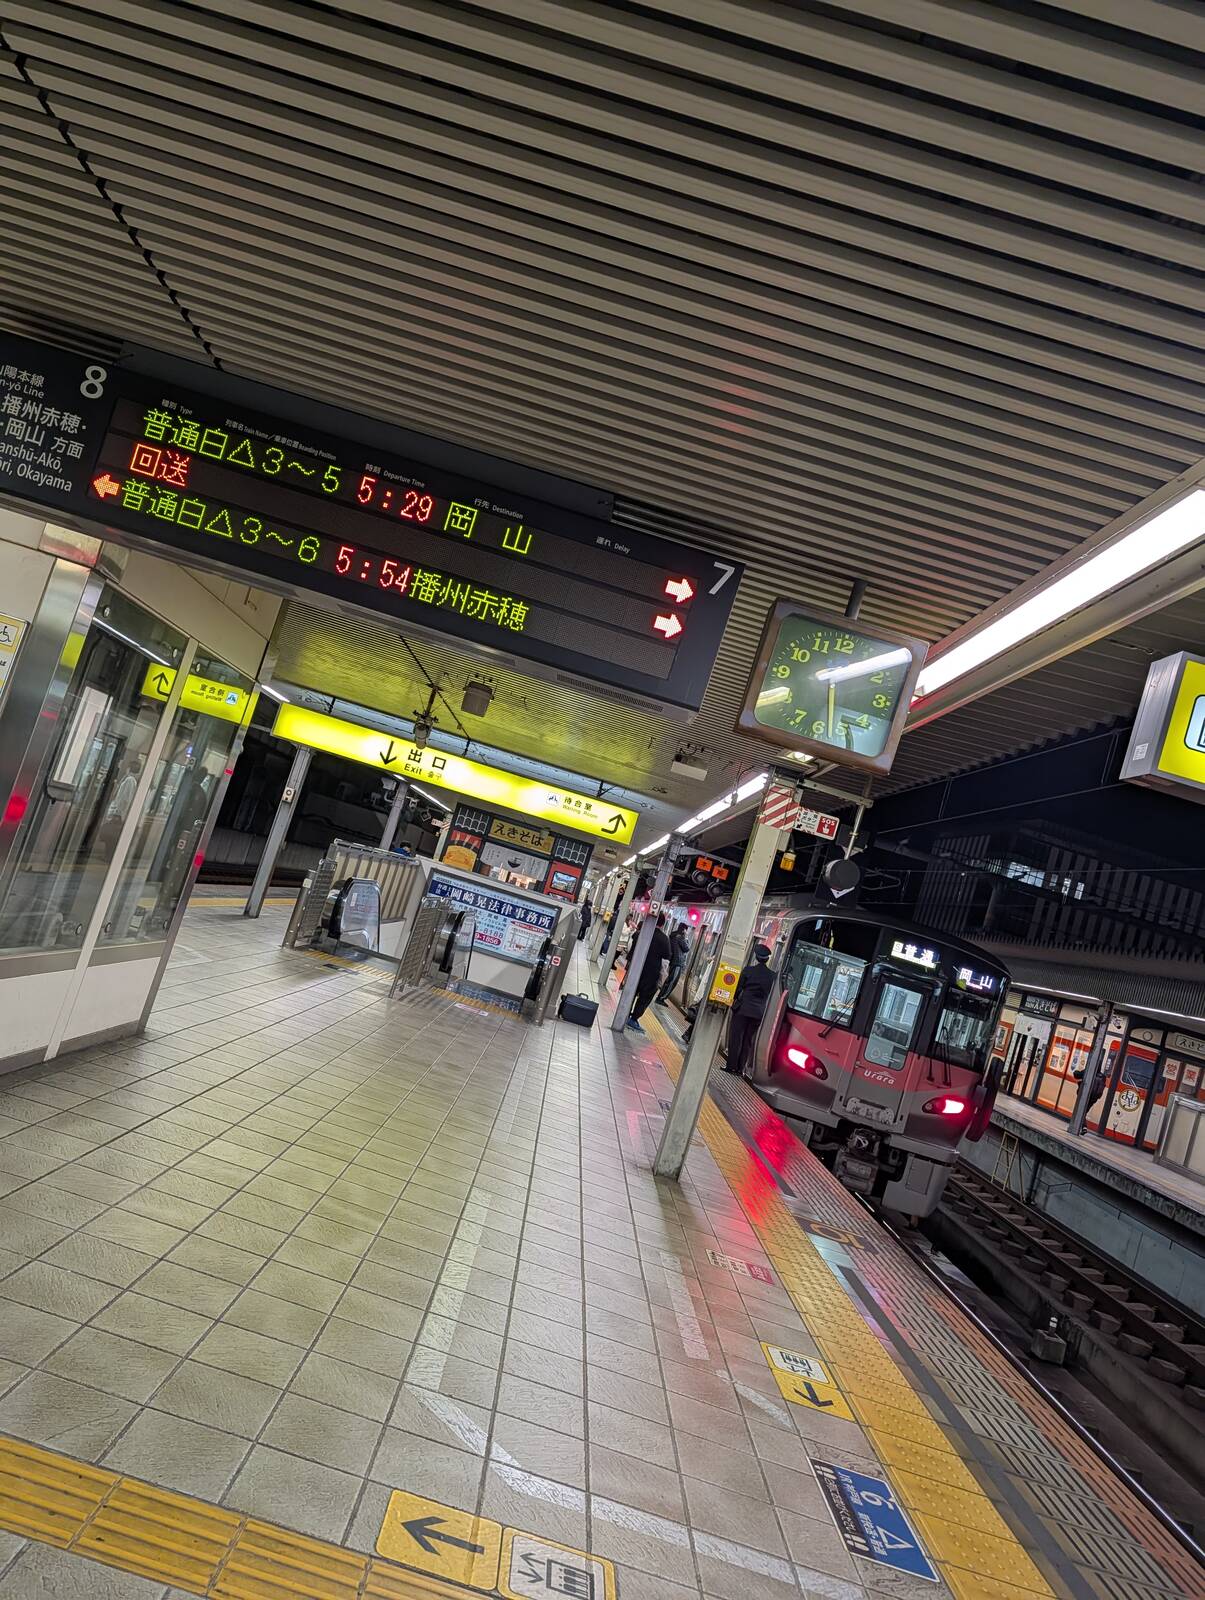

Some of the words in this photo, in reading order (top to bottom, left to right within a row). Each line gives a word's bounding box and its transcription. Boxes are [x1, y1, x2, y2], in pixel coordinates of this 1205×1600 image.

[79, 365, 108, 399] 8
[23, 385, 45, 399] Line
[179, 405, 193, 415] Type
[50, 436, 85, 460] 方面
[130, 443, 190, 487] 回送
[17, 462, 72, 492] Okayama
[383, 470, 411, 483] Departure
[411, 478, 425, 488] Time
[357, 475, 433, 522] 5:29
[474, 497, 489, 509] 行先
[492, 504, 524, 519] Destination
[614, 543, 631, 554] Delay
[335, 545, 411, 593] 5:54
[708, 561, 736, 595] 7
[408, 568, 530, 632] 播州赤穂
[812, 638, 829, 654] 11
[834, 638, 854, 655] 12
[790, 650, 811, 663] 10
[776, 665, 791, 679] 9
[870, 671, 884, 684] 2
[872, 694, 887, 708] 3
[794, 709, 807, 722] 7
[855, 713, 869, 728] 4
[811, 720, 825, 735] 6
[835, 721, 849, 736] 5
[408, 749, 446, 770] 出口
[404, 763, 422, 775] Exit
[822, 818, 835, 826] SOS
[495, 823, 544, 847] えきそば
[863, 1070, 895, 1085] Urara
[860, 1490, 895, 1511] 6
